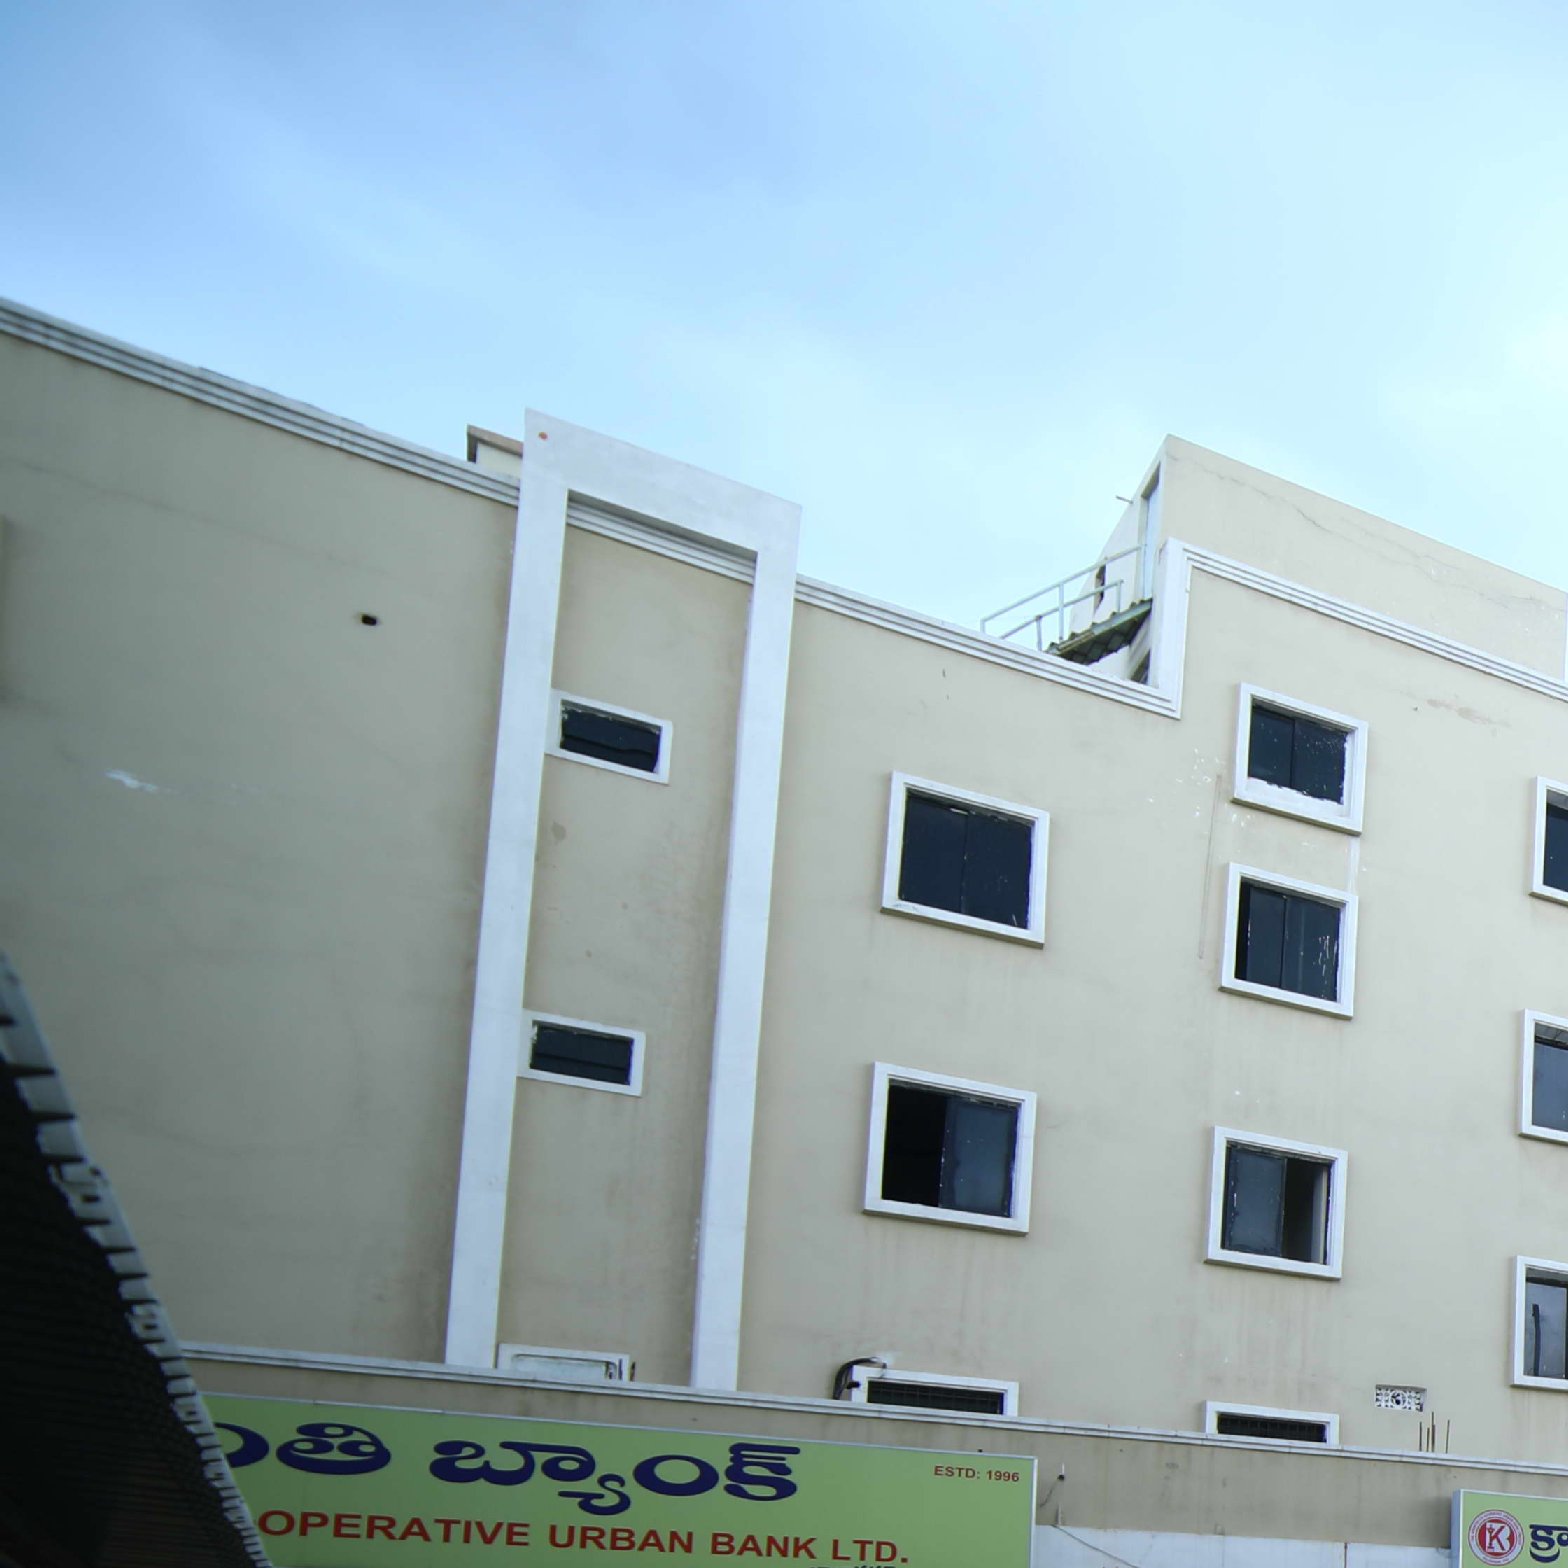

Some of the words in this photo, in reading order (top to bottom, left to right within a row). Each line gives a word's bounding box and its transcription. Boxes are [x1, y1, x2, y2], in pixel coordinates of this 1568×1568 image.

[213, 1421, 392, 1476] ంతి
[428, 1440, 802, 1517] బ్యాంక్
[933, 1464, 981, 1480] ESTD:
[986, 1469, 1021, 1483] 1996
[547, 1523, 695, 1554] URBAN
[710, 1531, 818, 1560] BANK
[831, 1538, 910, 1564] LTD.
